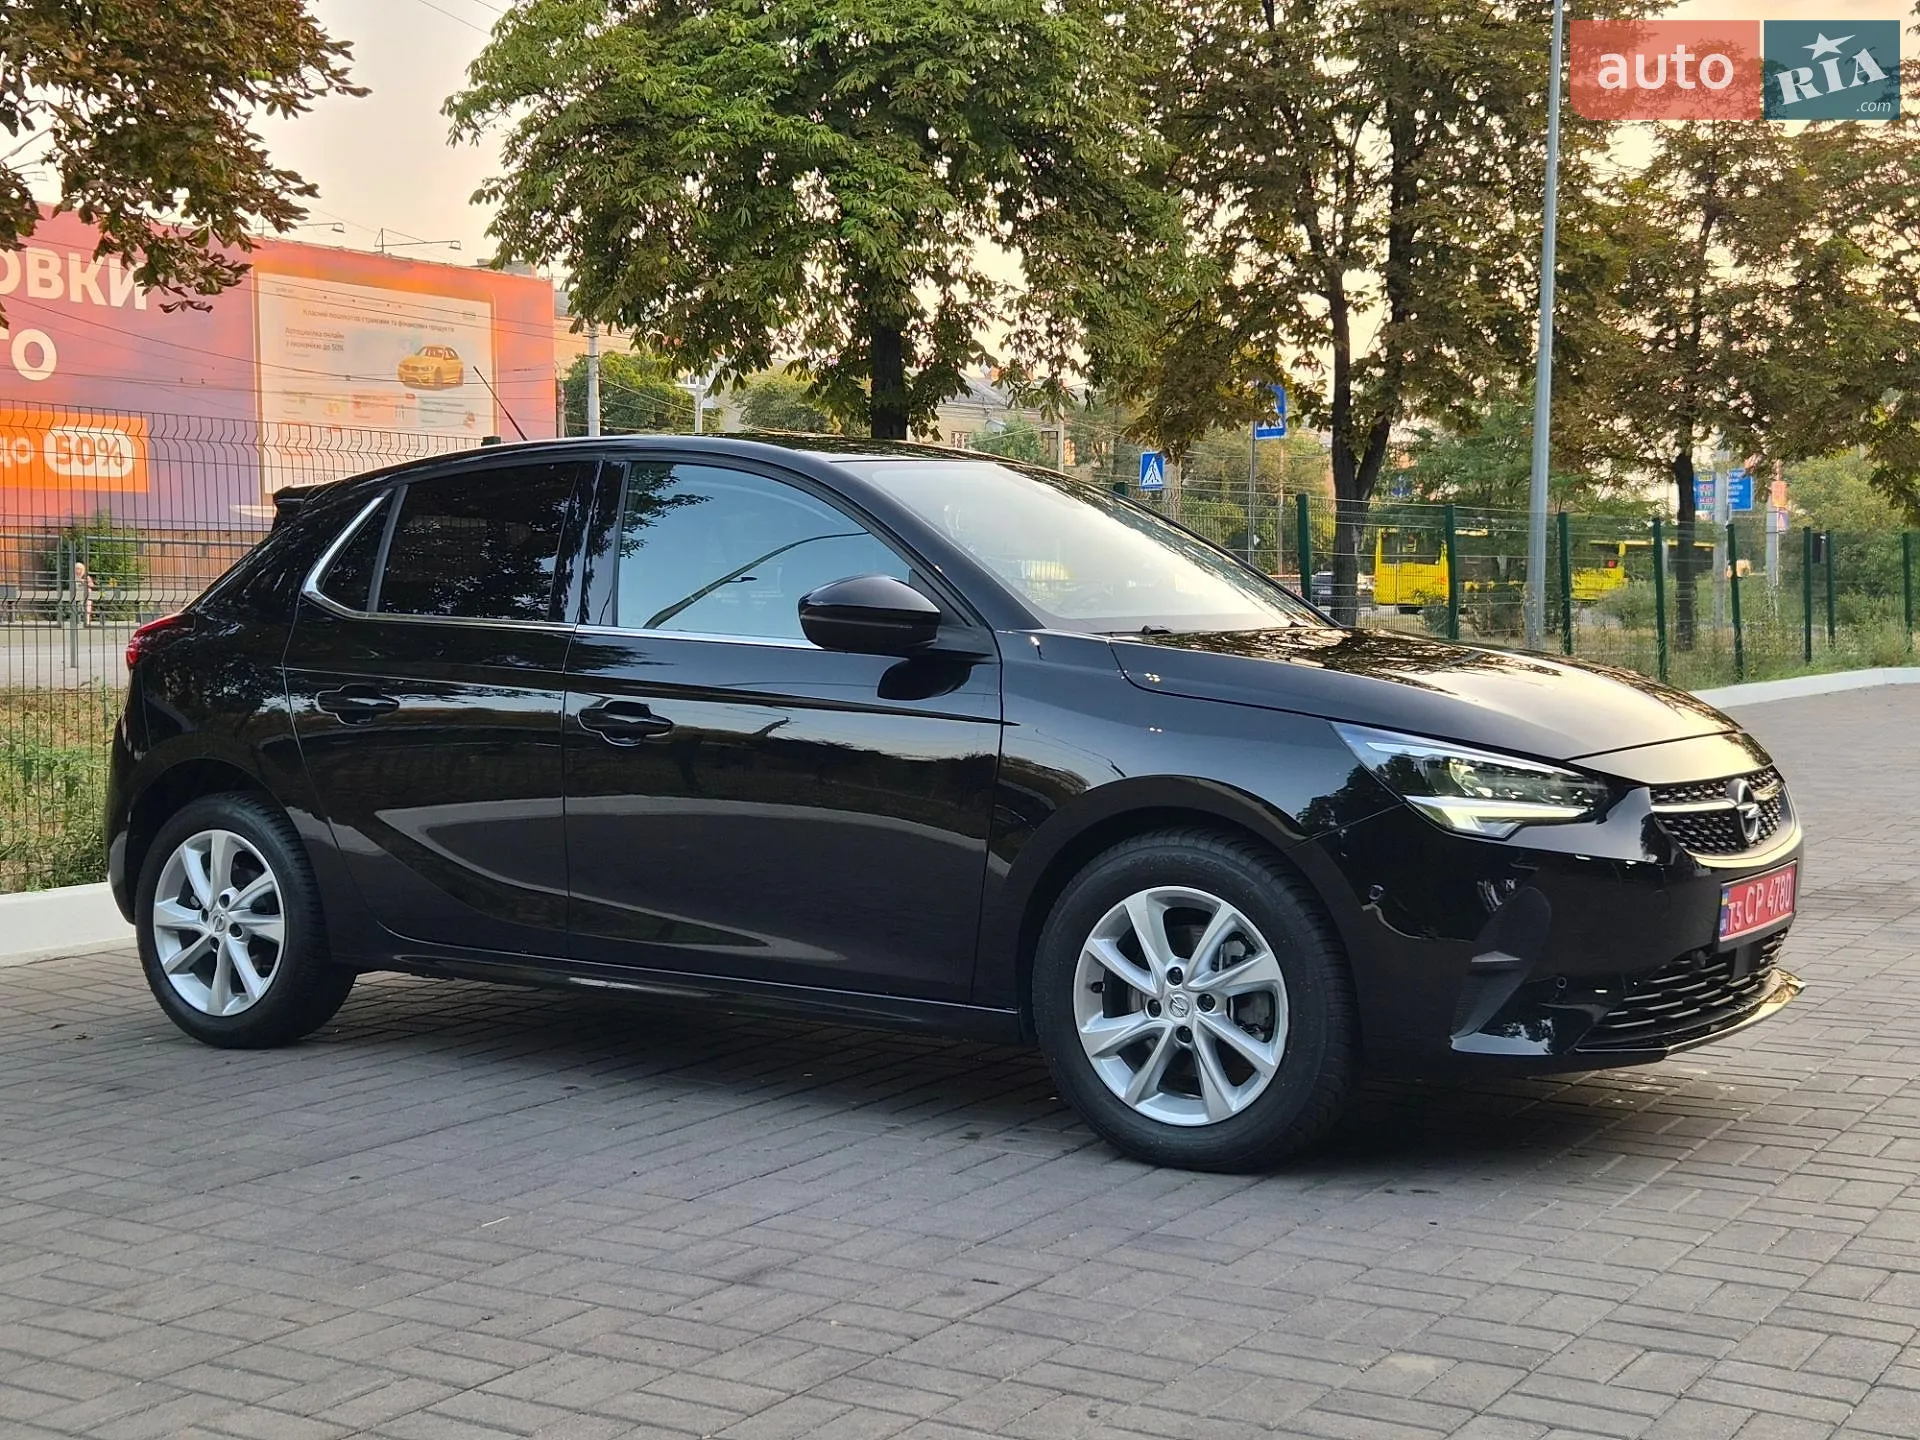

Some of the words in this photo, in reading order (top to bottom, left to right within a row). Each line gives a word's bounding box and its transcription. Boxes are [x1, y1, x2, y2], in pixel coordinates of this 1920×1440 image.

[0, 326, 57, 381] О
[55, 434, 126, 468] 50%
[1728, 900, 1743, 932] T5
[1745, 883, 1764, 924] CP
[1767, 872, 1792, 916] 4780
